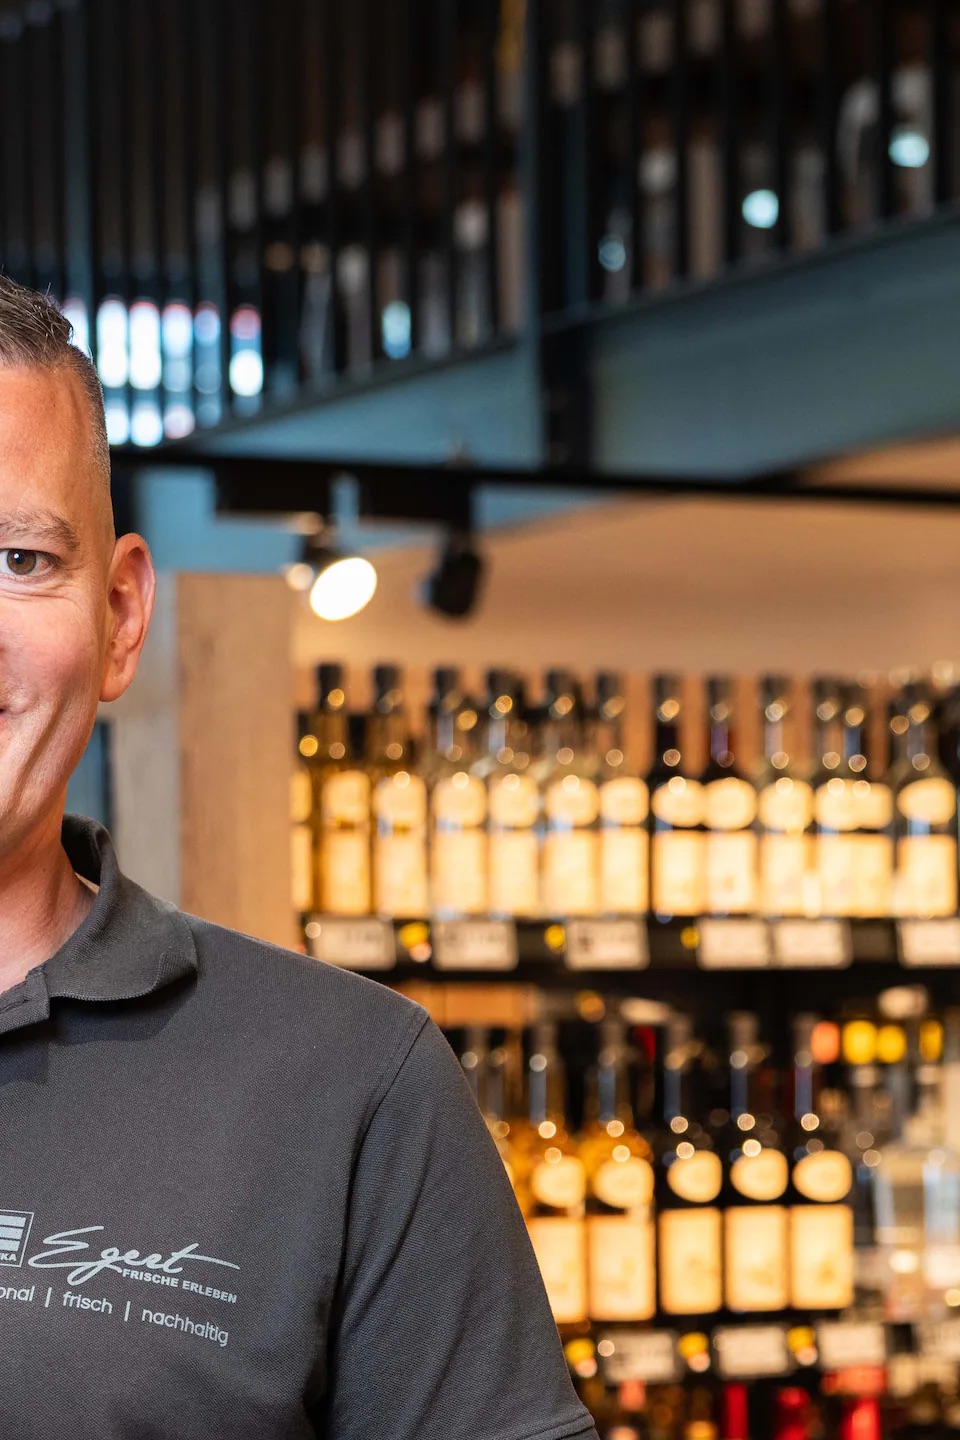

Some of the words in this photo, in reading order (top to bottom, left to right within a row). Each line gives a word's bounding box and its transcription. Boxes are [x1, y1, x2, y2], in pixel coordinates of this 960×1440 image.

[28, 1225, 240, 1285] Egert
[122, 1268, 179, 1288] FRISCHE
[182, 1280, 237, 1303] ERLEBEN
[62, 1291, 113, 1314] frisch
[141, 1309, 229, 1346] nachhaltig
